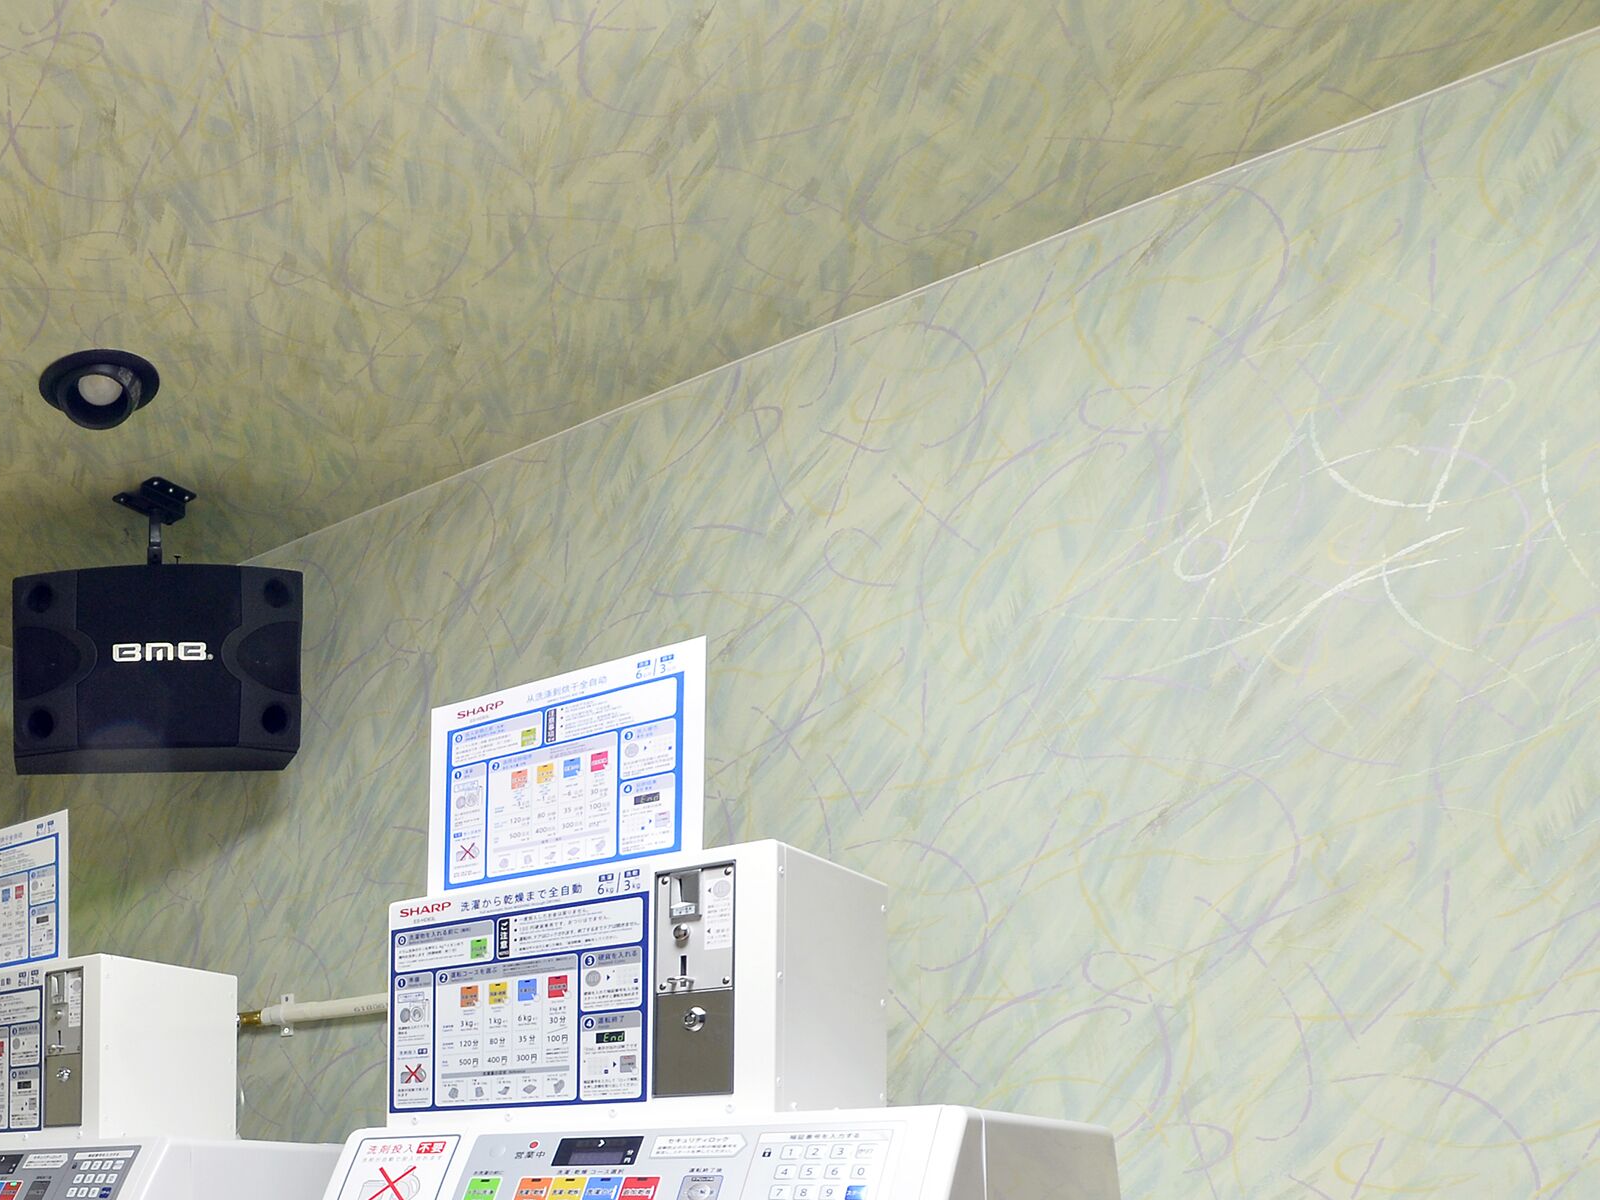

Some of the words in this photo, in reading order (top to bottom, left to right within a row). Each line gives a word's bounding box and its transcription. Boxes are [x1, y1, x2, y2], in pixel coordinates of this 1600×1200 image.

[457, 700, 504, 720] SHARP
[461, 883, 583, 912] 洗濯から乾燥まで全自動
[399, 901, 452, 918] SHARP
[602, 1030, 624, 1043] End
[512, 1149, 547, 1160] 営業中
